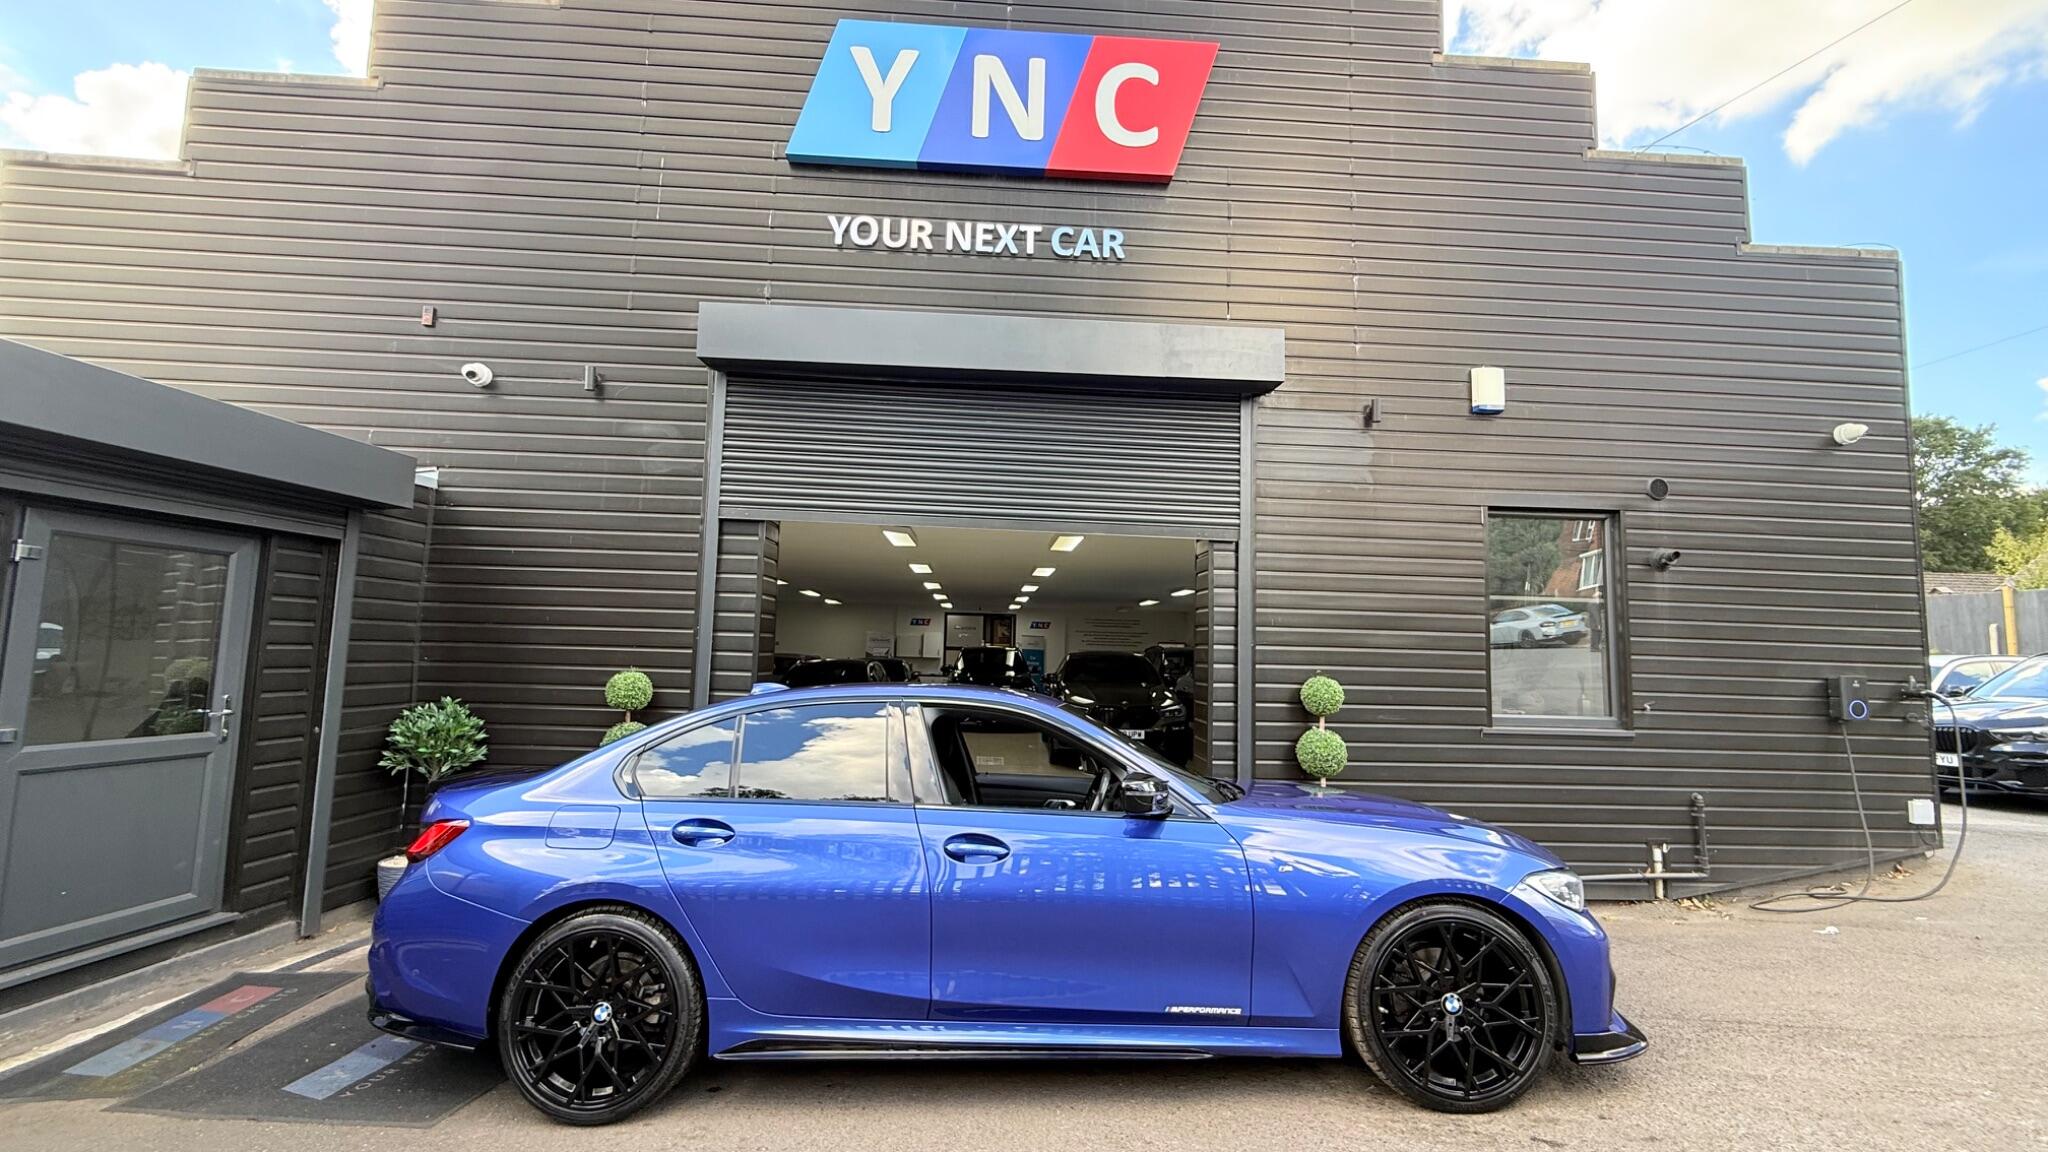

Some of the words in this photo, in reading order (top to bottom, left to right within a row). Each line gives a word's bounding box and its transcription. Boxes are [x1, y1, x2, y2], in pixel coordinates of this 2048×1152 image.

[850, 46, 1160, 148] YNC
[827, 214, 934, 250] YOUR
[945, 221, 1043, 255] NEXT
[1051, 227, 1126, 260] CAR
[1178, 1006, 1241, 1014] PERFORMANCE
[337, 1068, 400, 1098] YOUR
